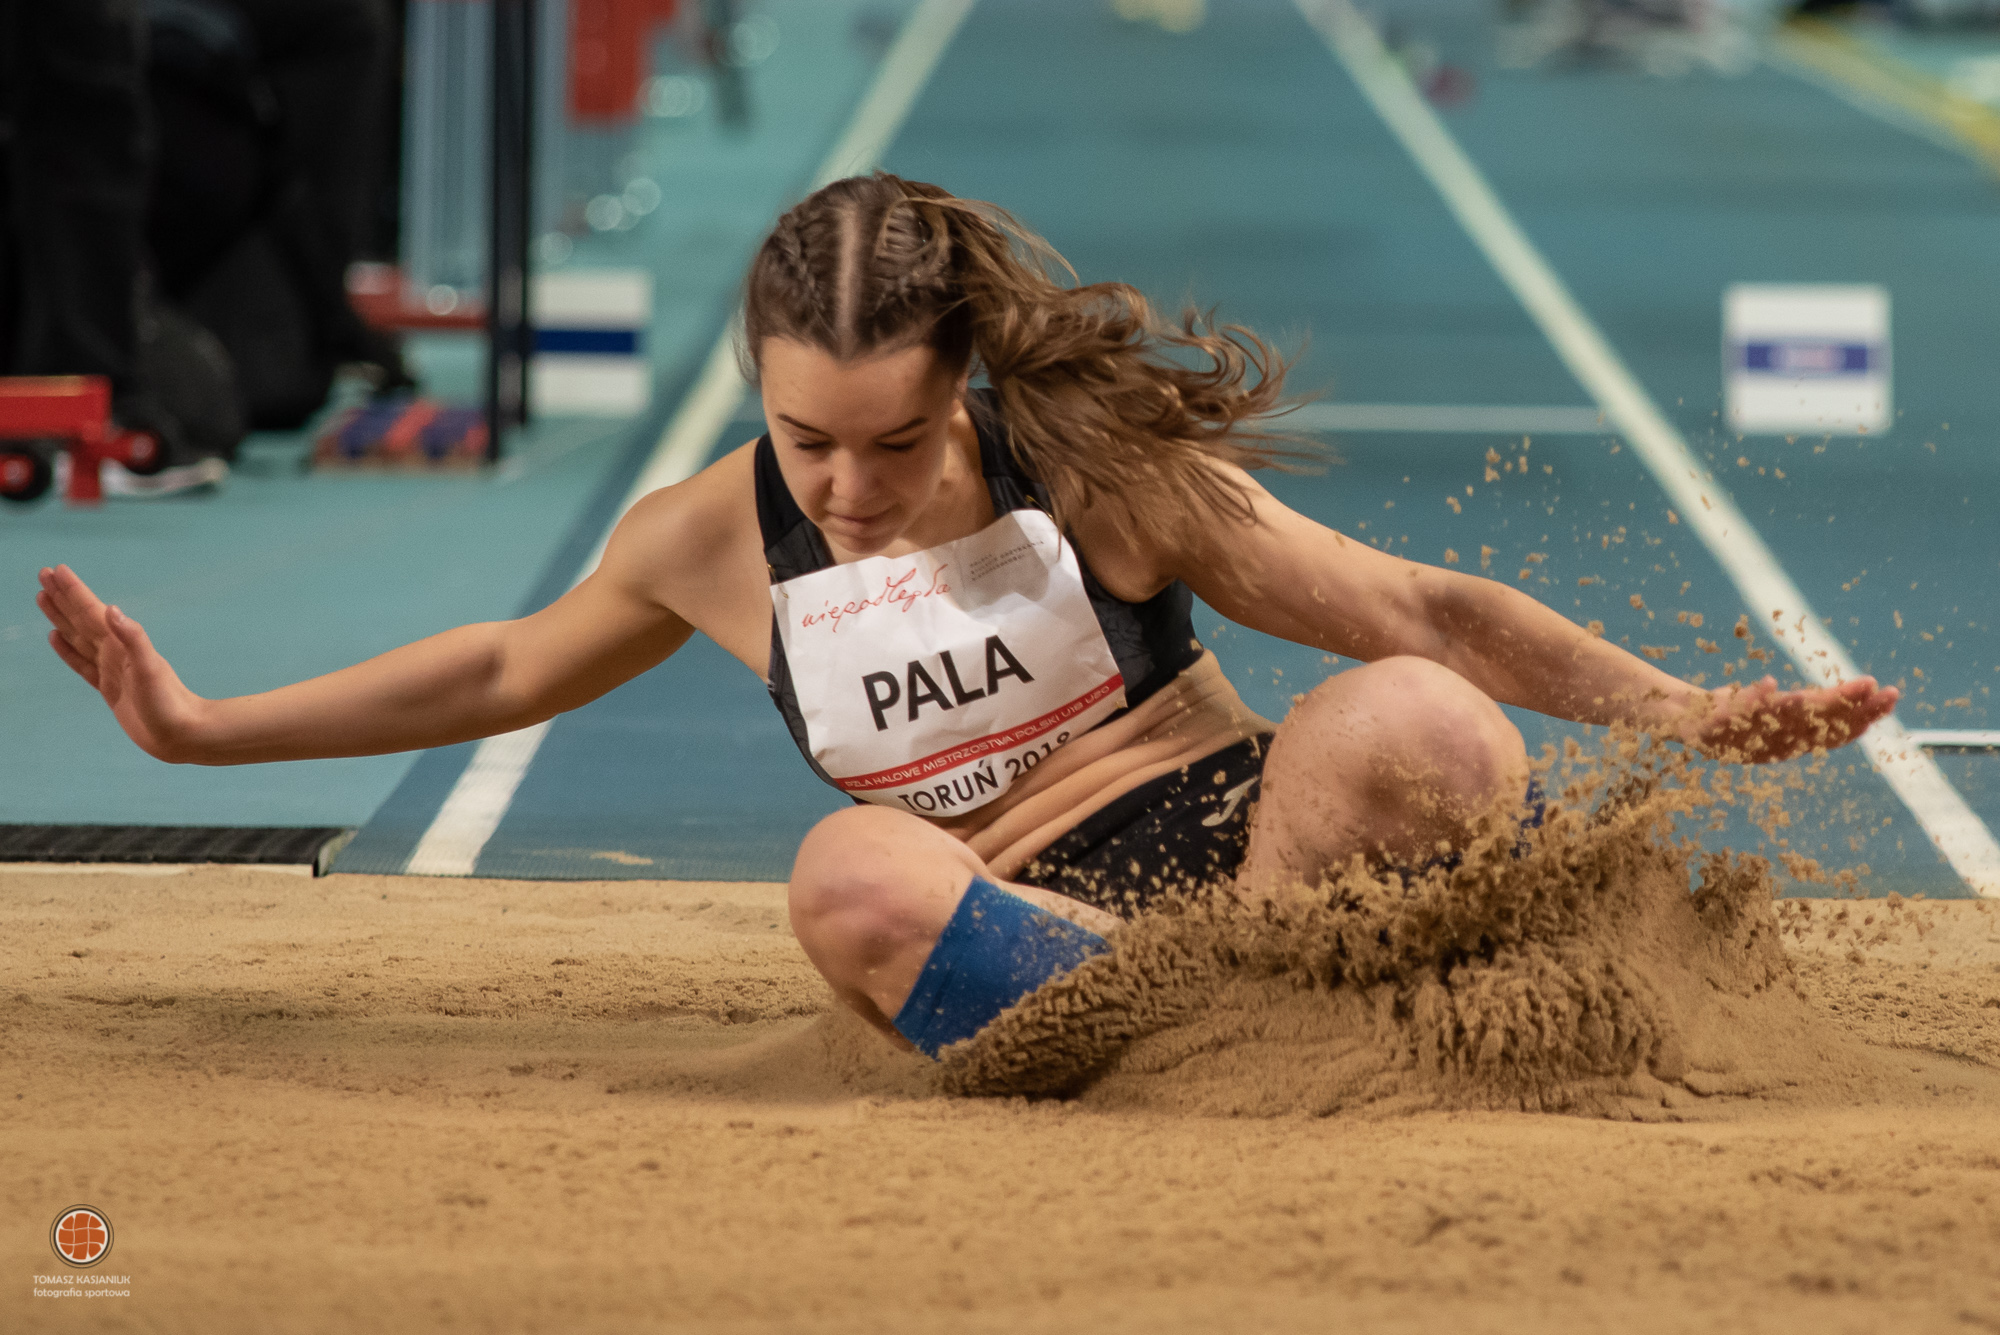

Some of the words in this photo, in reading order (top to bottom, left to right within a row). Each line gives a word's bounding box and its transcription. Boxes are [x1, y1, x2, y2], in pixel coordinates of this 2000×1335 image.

[862, 634, 1035, 732] PALA
[875, 767, 921, 785] HALOWE
[923, 735, 1015, 773] MISTRZOSTWA
[1013, 714, 1060, 740] POLSKI
[897, 760, 999, 811] TORUŃ
